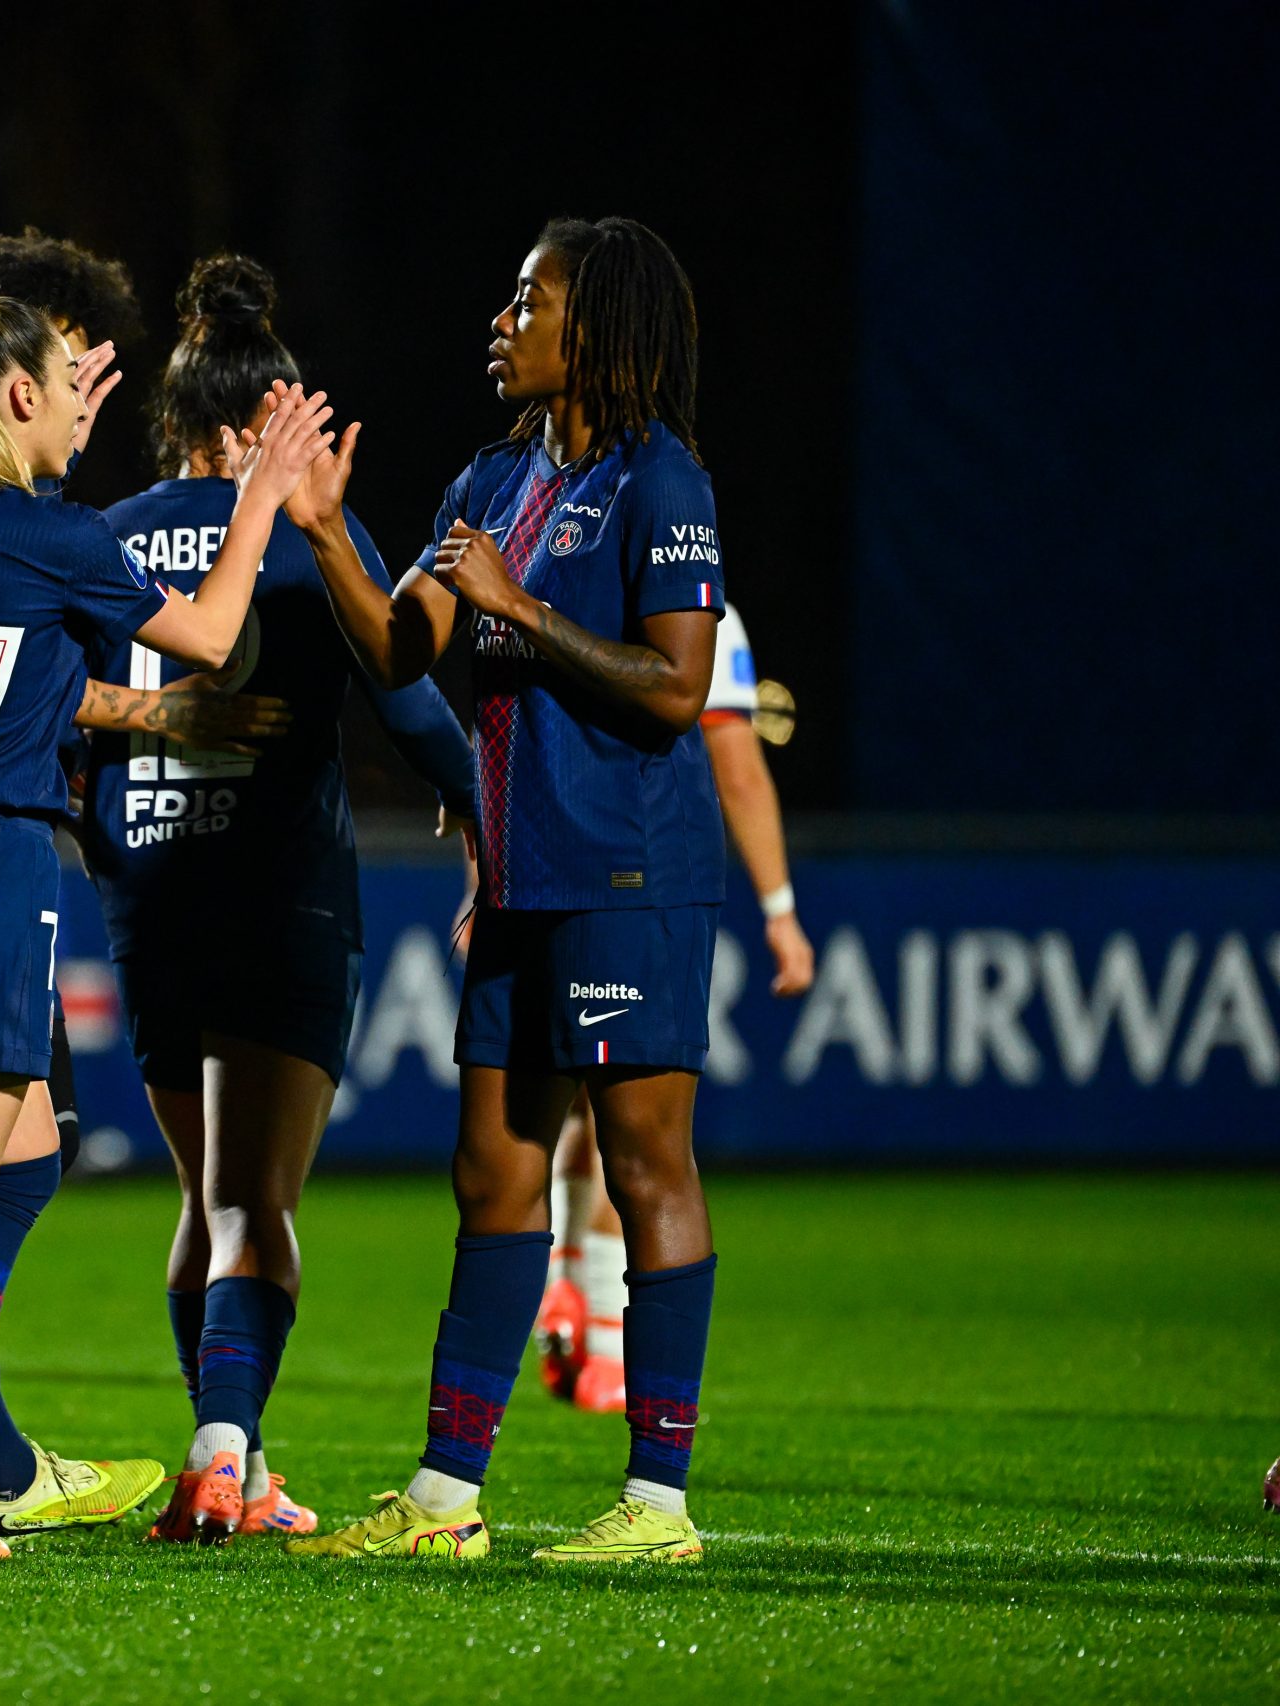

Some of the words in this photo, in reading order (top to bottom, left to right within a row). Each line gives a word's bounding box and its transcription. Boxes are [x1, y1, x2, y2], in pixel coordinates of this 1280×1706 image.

[671, 524, 715, 546] VISIT
[475, 635, 548, 661] AIRWAY
[126, 814, 231, 849] UNITED
[569, 982, 643, 1001] Deloitte.
[783, 929, 1280, 1087] AIRWA
